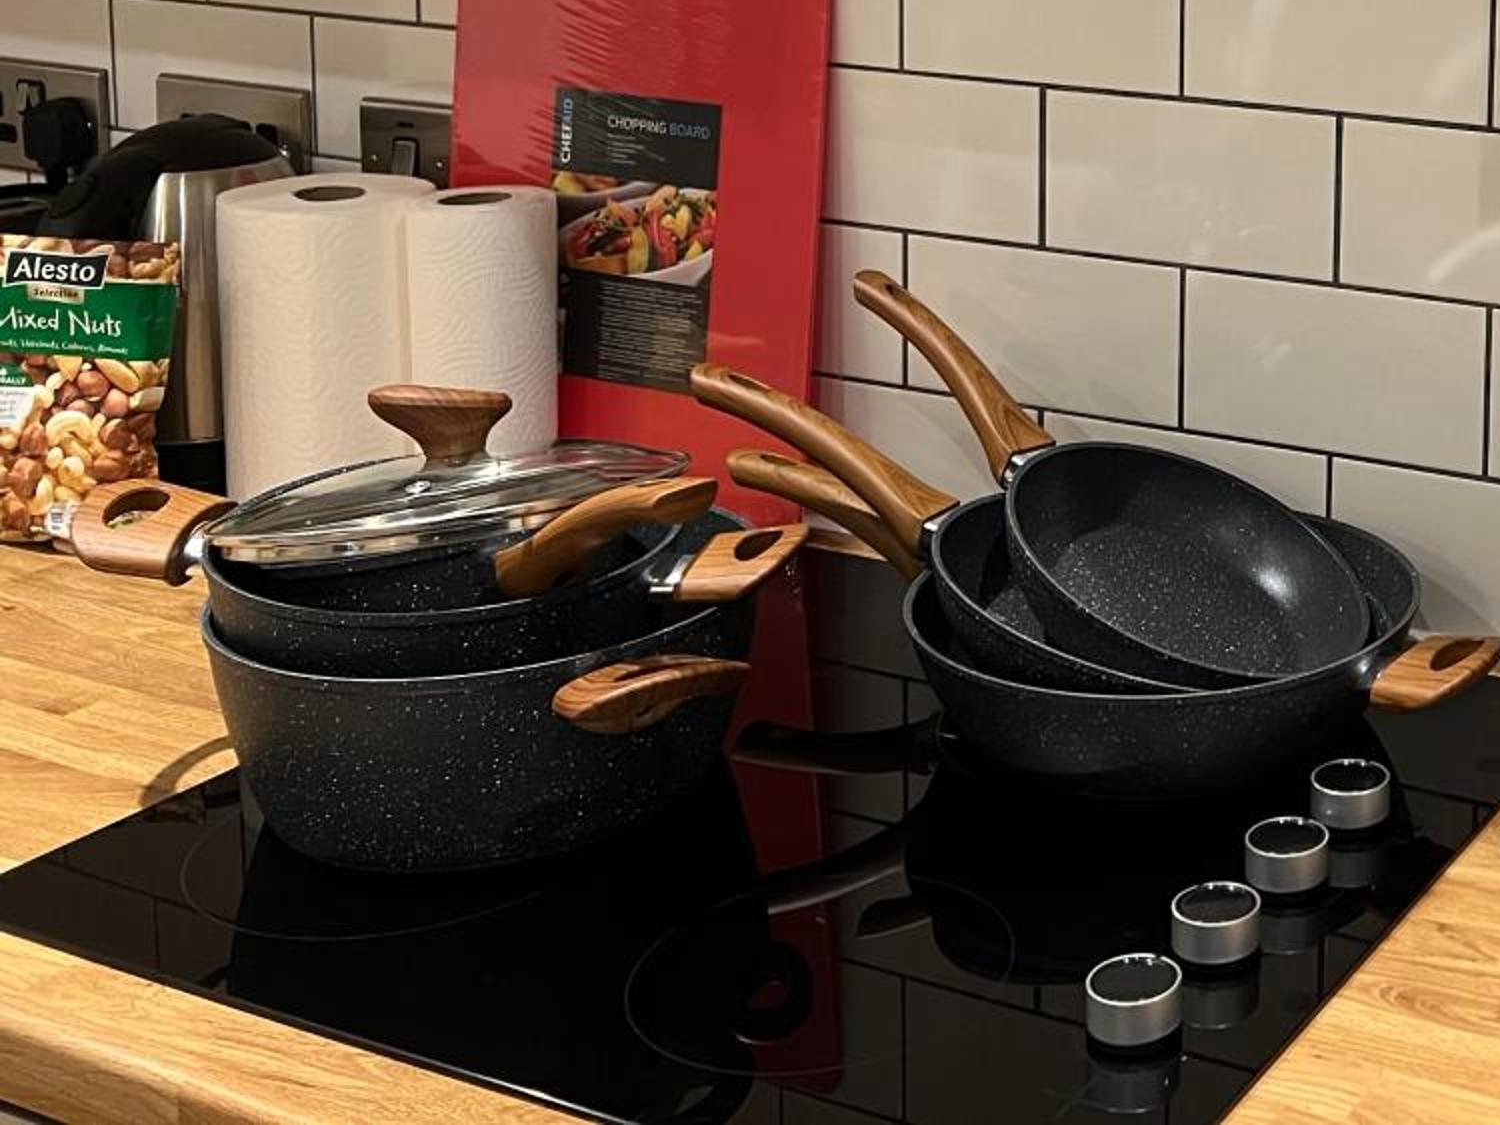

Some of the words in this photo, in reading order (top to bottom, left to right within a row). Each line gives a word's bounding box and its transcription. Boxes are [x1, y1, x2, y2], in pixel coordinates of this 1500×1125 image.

[607, 114, 667, 135] CHOPPING
[669, 122, 711, 140] BOARD
[13, 256, 96, 282] Alesto
[67, 309, 122, 337] Nuts
